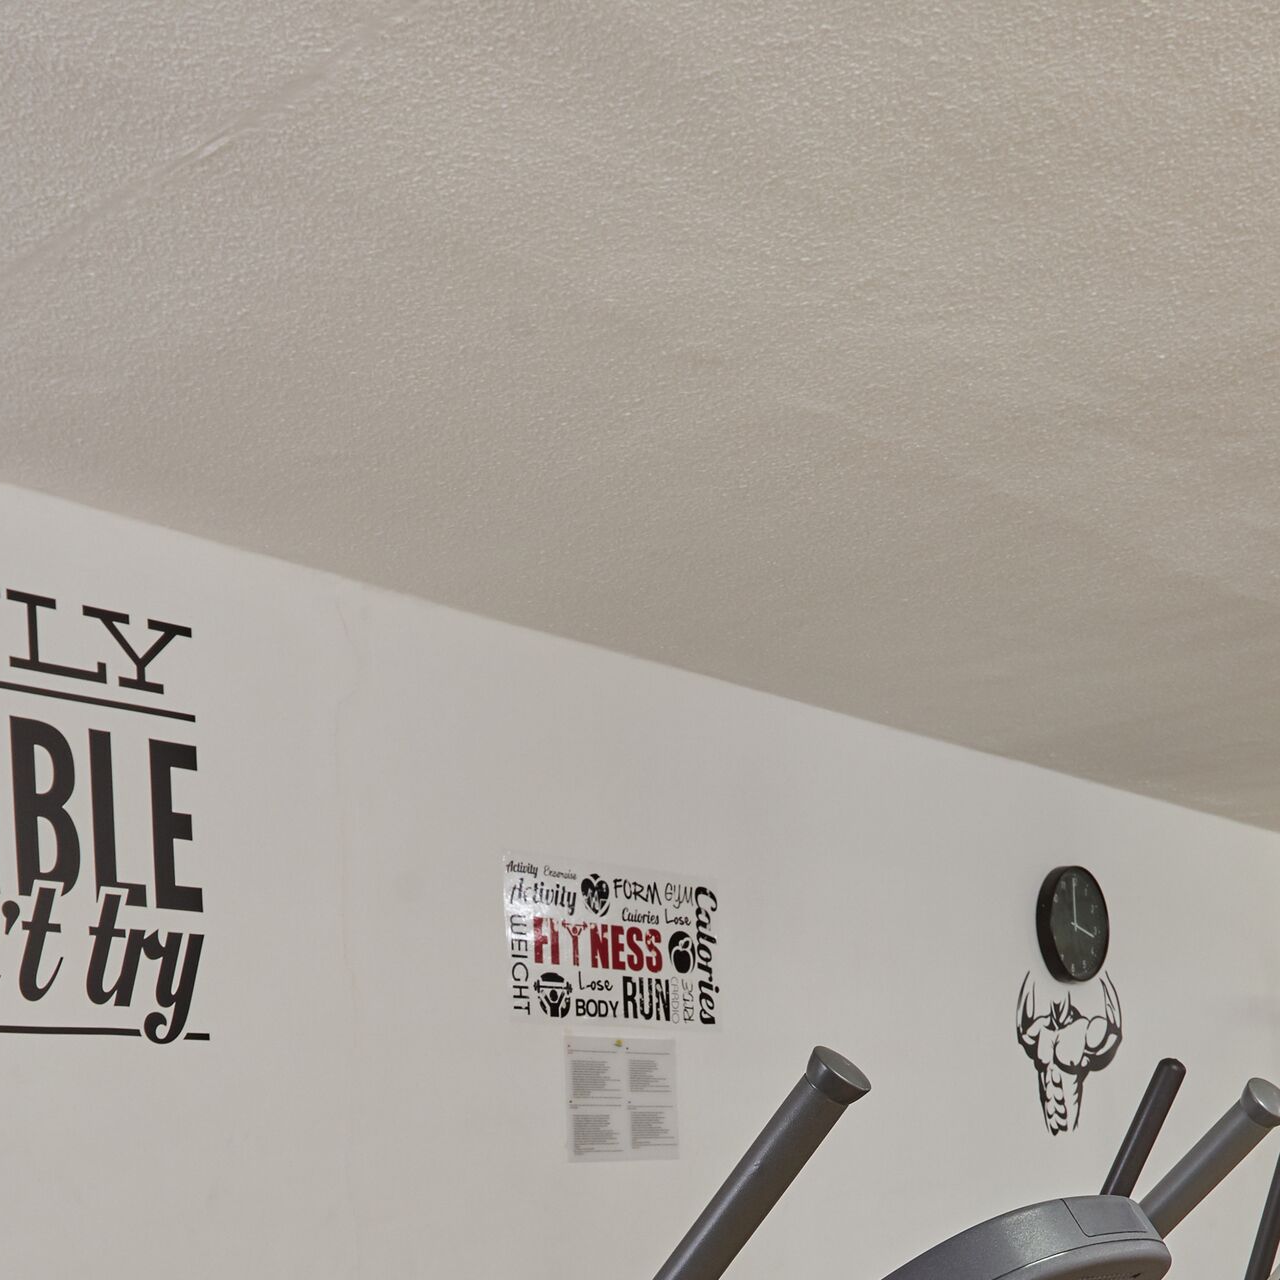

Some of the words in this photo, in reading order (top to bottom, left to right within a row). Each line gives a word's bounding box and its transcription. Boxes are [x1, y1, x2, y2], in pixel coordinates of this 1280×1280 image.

[510, 878, 578, 916] Activity
[612, 878, 662, 906] FORM
[665, 908, 692, 926] Lose
[84, 884, 206, 1045] try
[509, 914, 531, 1015] WEIGHT
[533, 916, 663, 974] FITNESS
[695, 886, 719, 1025] Calories
[578, 971, 614, 991] Lose
[622, 975, 671, 1022] RUN
[575, 998, 620, 1018] BODY
